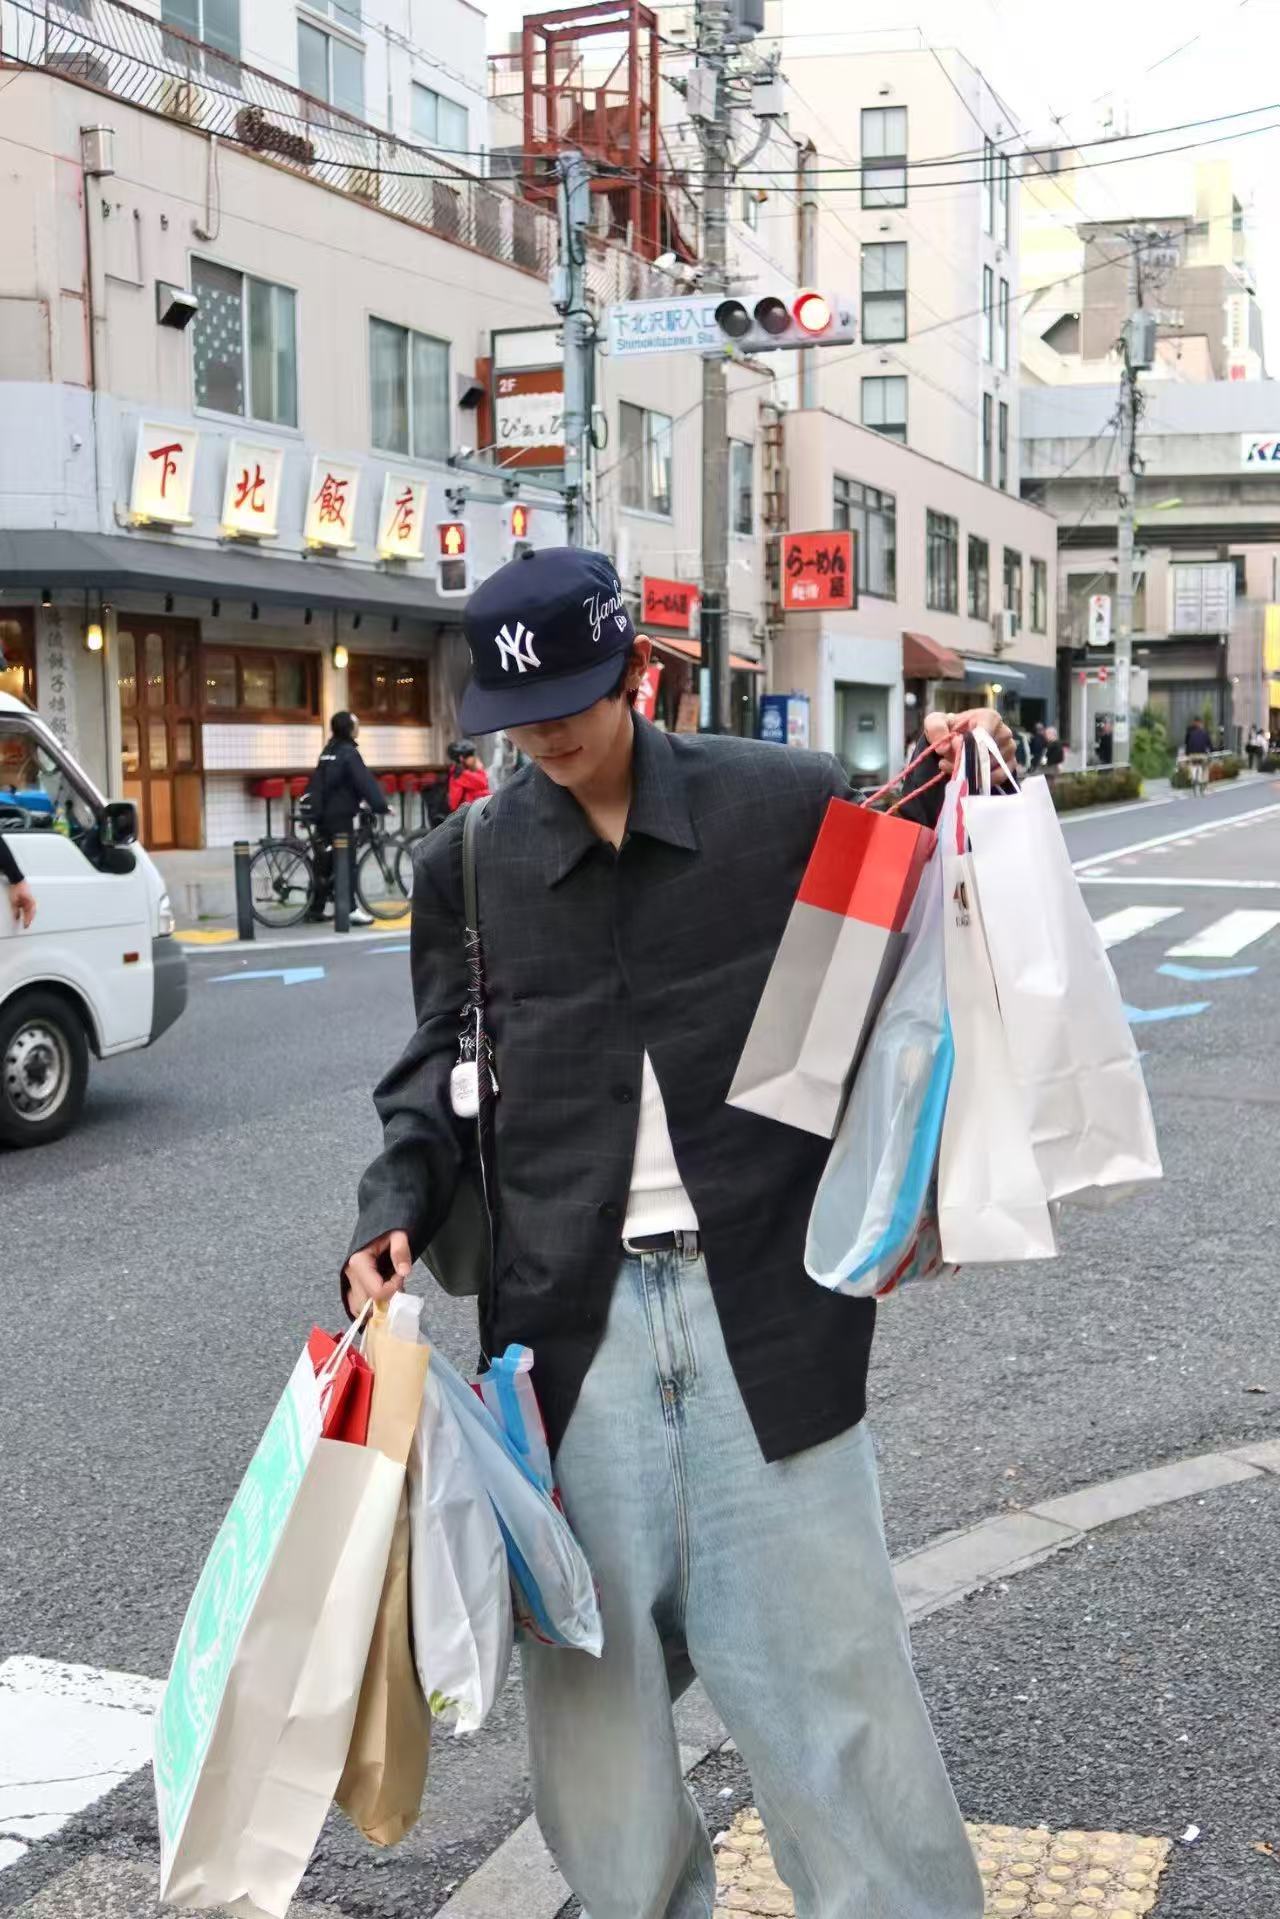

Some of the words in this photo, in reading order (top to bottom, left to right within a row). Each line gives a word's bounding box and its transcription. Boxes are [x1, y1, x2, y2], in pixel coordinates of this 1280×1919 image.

[499, 378, 517, 393] 2F
[148, 443, 415, 540] 下北飯店
[785, 544, 846, 577] らーめん
[494, 621, 542, 673] NY
